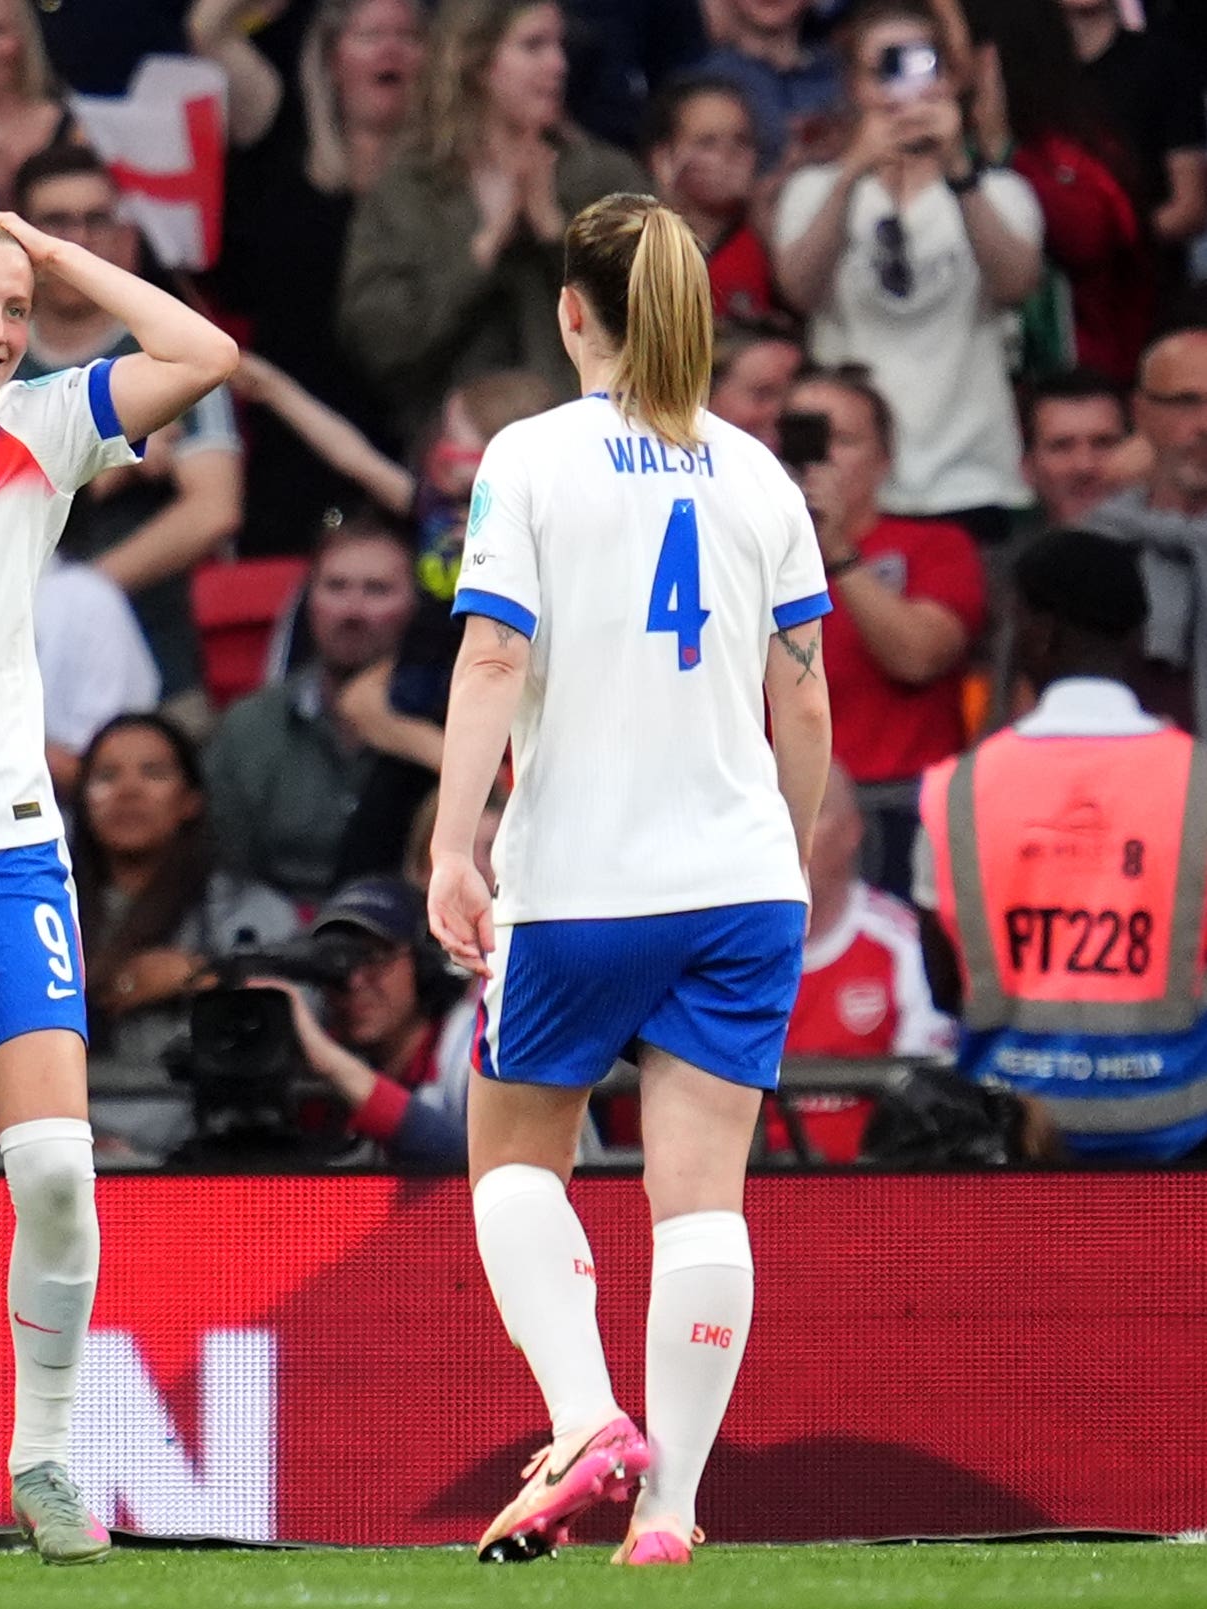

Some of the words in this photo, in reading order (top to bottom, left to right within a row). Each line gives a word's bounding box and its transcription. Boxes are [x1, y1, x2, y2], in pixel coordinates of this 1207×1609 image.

[604, 436, 714, 477] WALSH
[646, 498, 711, 671] 4
[1123, 838, 1144, 876] 8
[34, 903, 73, 982] 9
[1005, 906, 1153, 975] PT228
[690, 1322, 733, 1349] ENG
